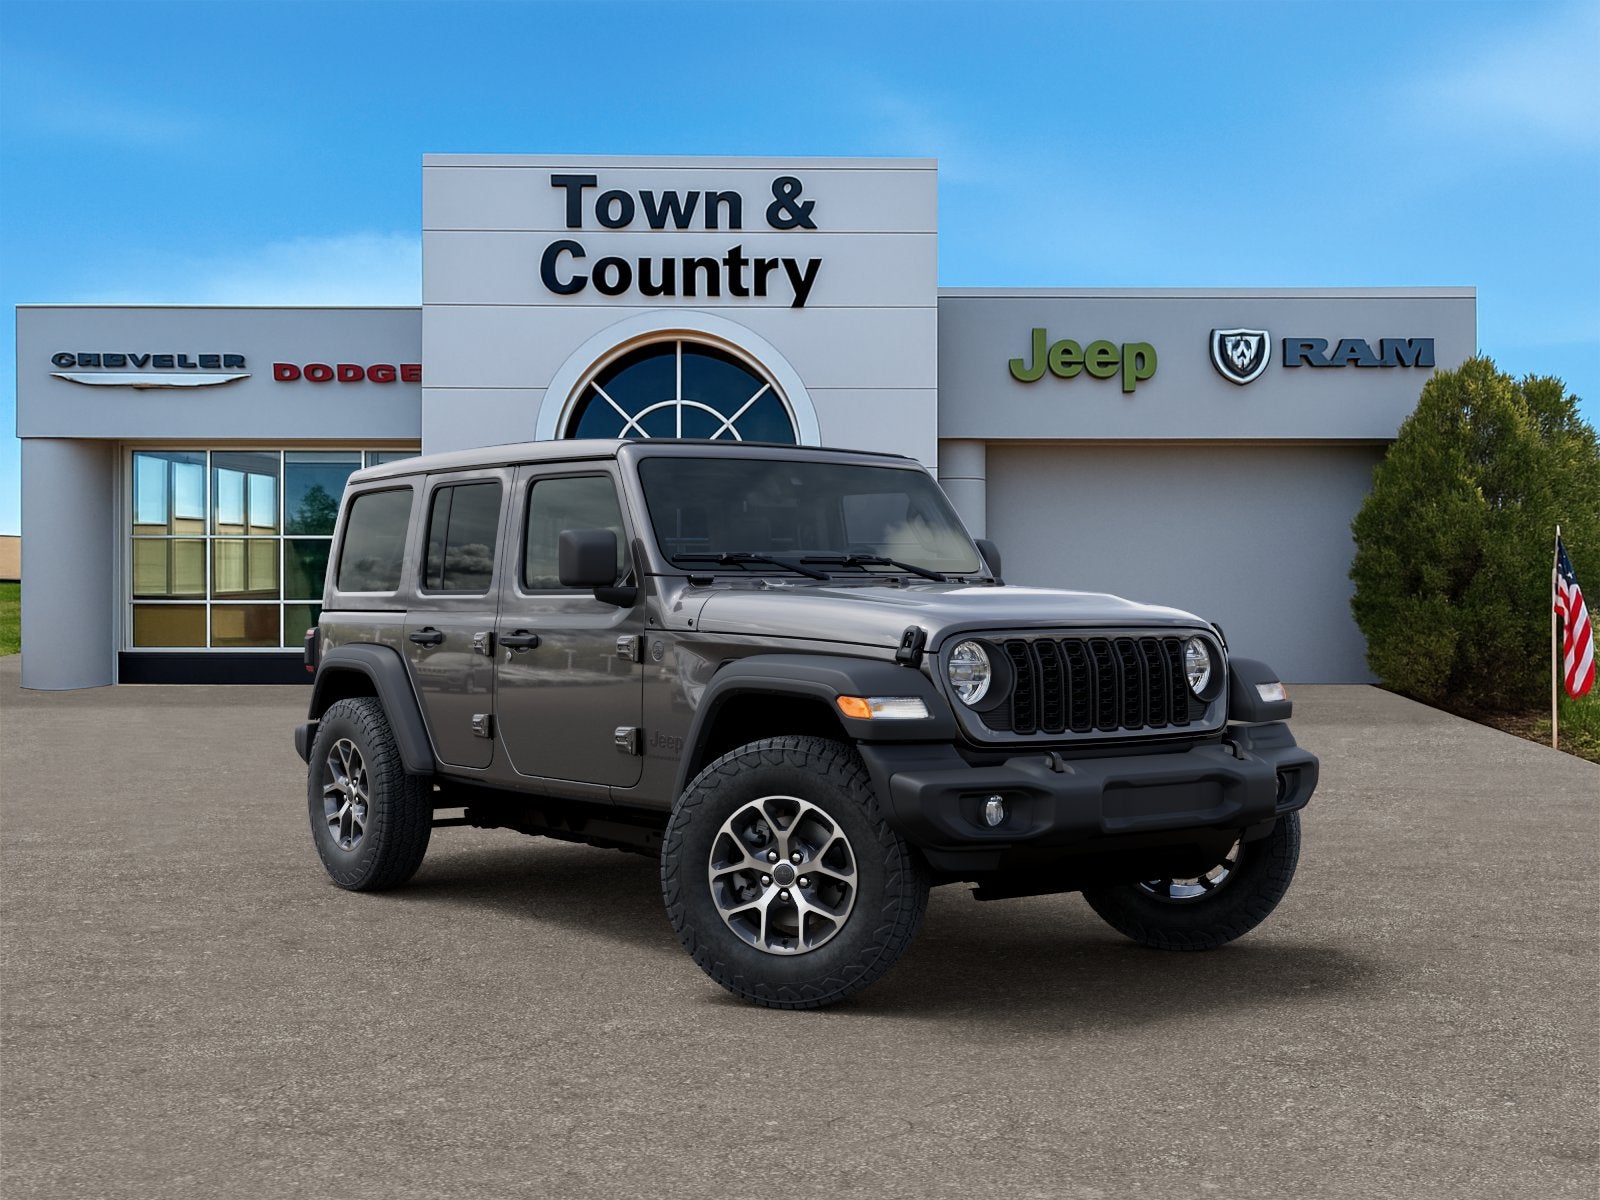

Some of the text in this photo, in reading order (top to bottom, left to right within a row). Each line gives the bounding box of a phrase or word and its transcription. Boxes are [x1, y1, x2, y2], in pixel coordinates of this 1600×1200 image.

[550, 174, 818, 230] Town &
[540, 239, 823, 308] Country
[272, 362, 422, 383] DODGE
[1008, 327, 1158, 393] Jeep
[1282, 337, 1435, 368] RAM
[649, 729, 683, 754] Jeep
